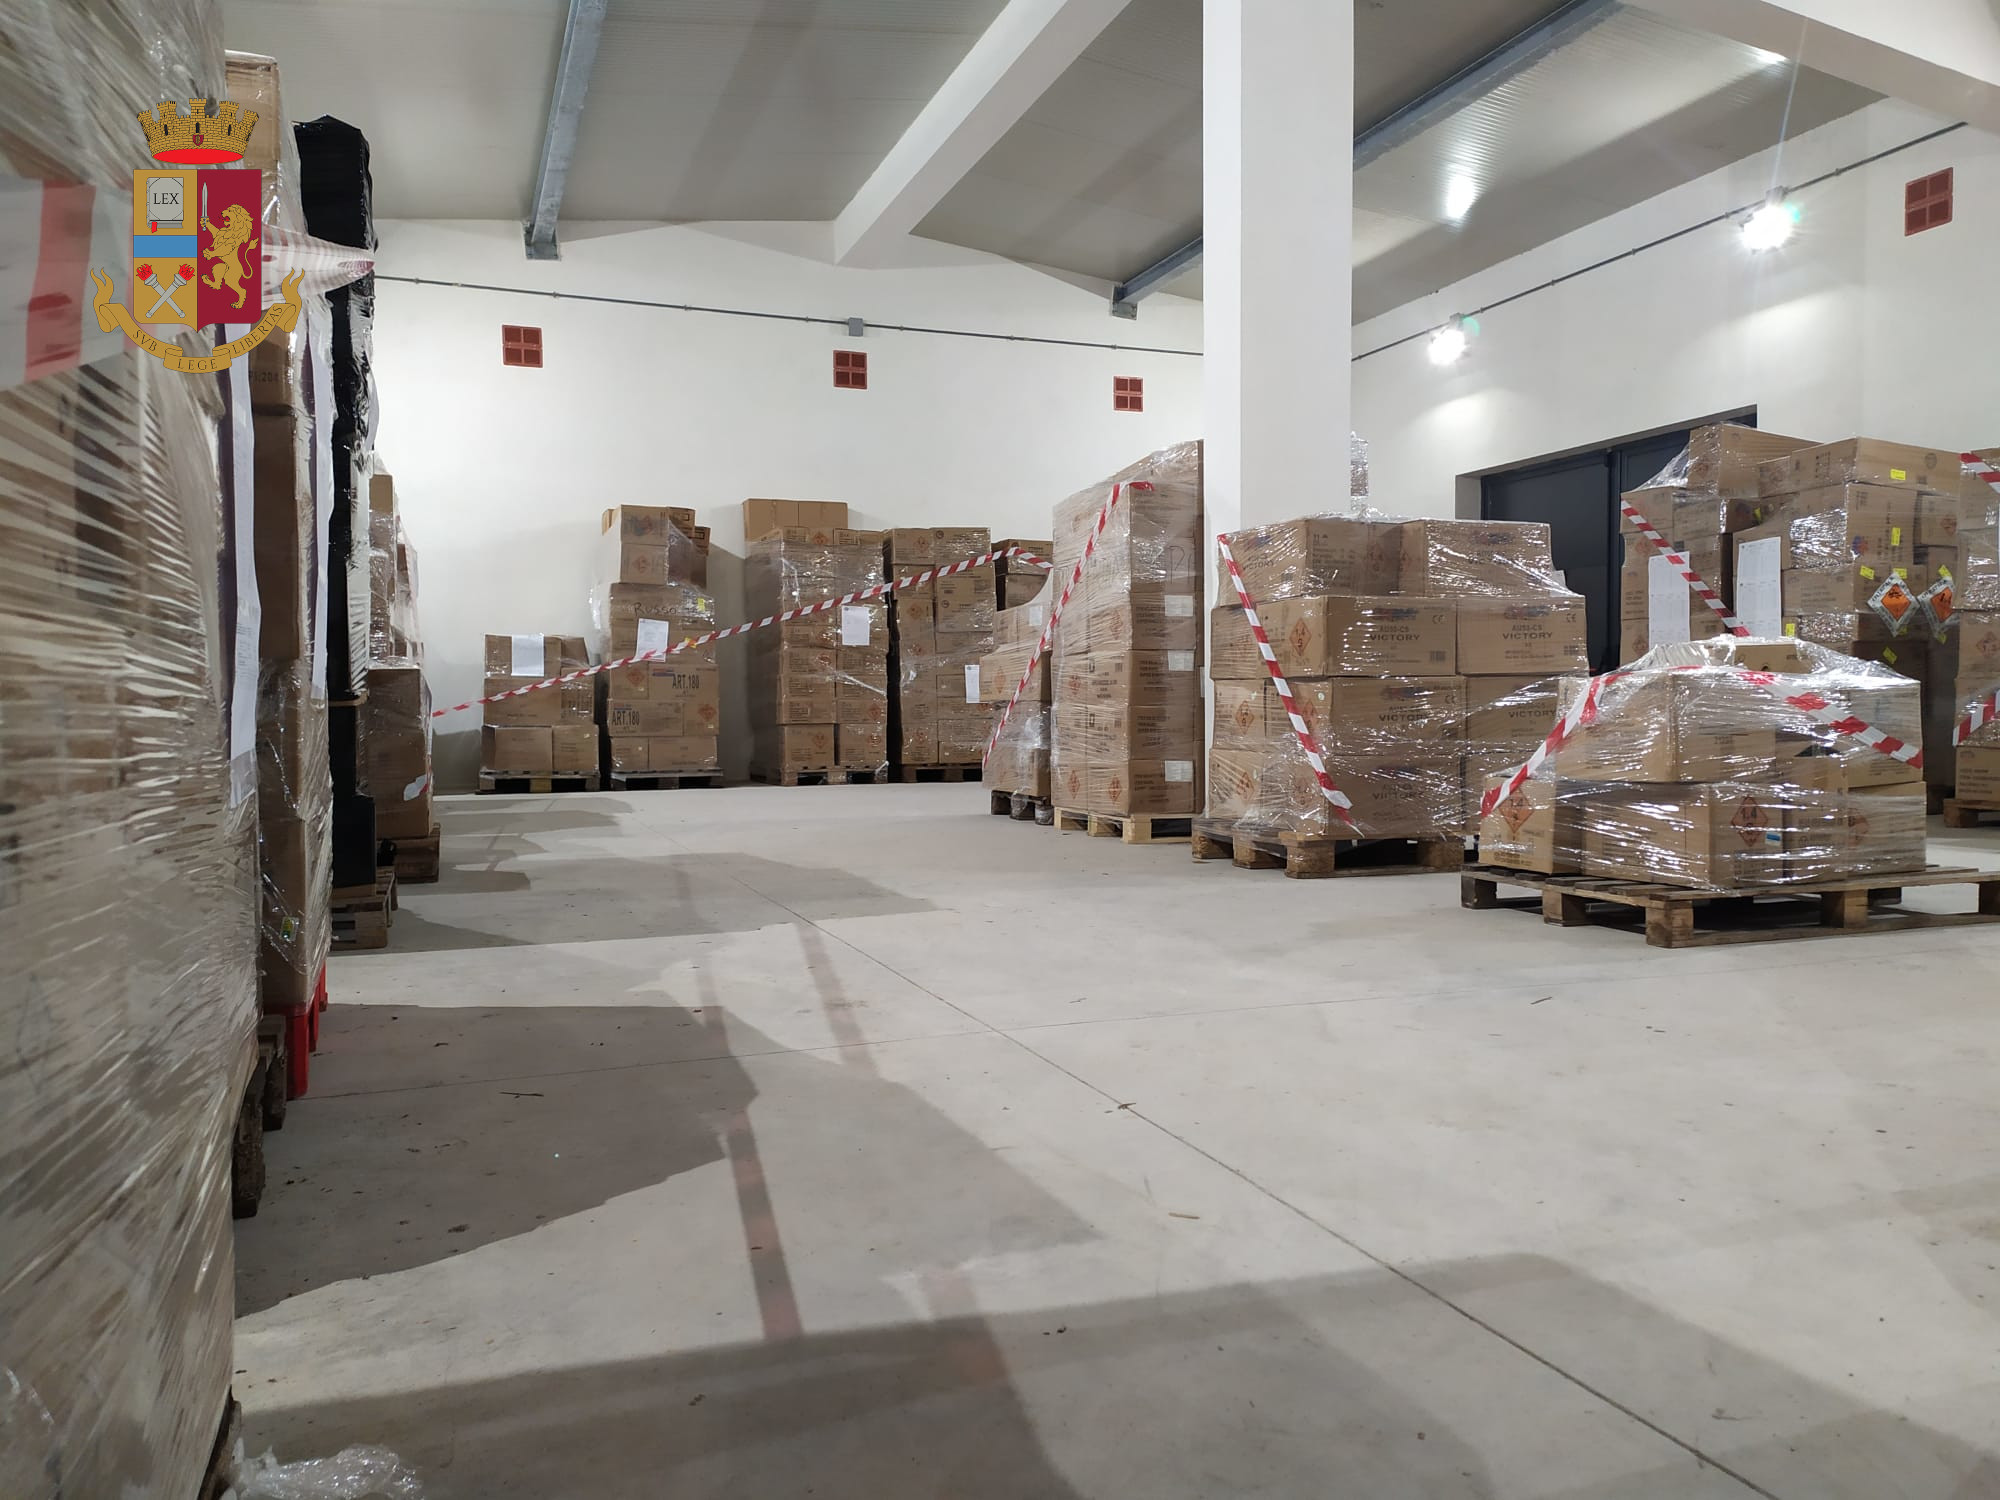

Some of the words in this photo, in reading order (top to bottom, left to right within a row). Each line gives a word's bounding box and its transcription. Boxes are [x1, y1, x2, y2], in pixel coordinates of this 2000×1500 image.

[1369, 633, 1420, 641] VICTORY
[1502, 631, 1553, 640] VICTORY
[672, 673, 700, 689] ART.180
[611, 710, 640, 726] ART.180
[1508, 709, 1557, 719] VICTORY
